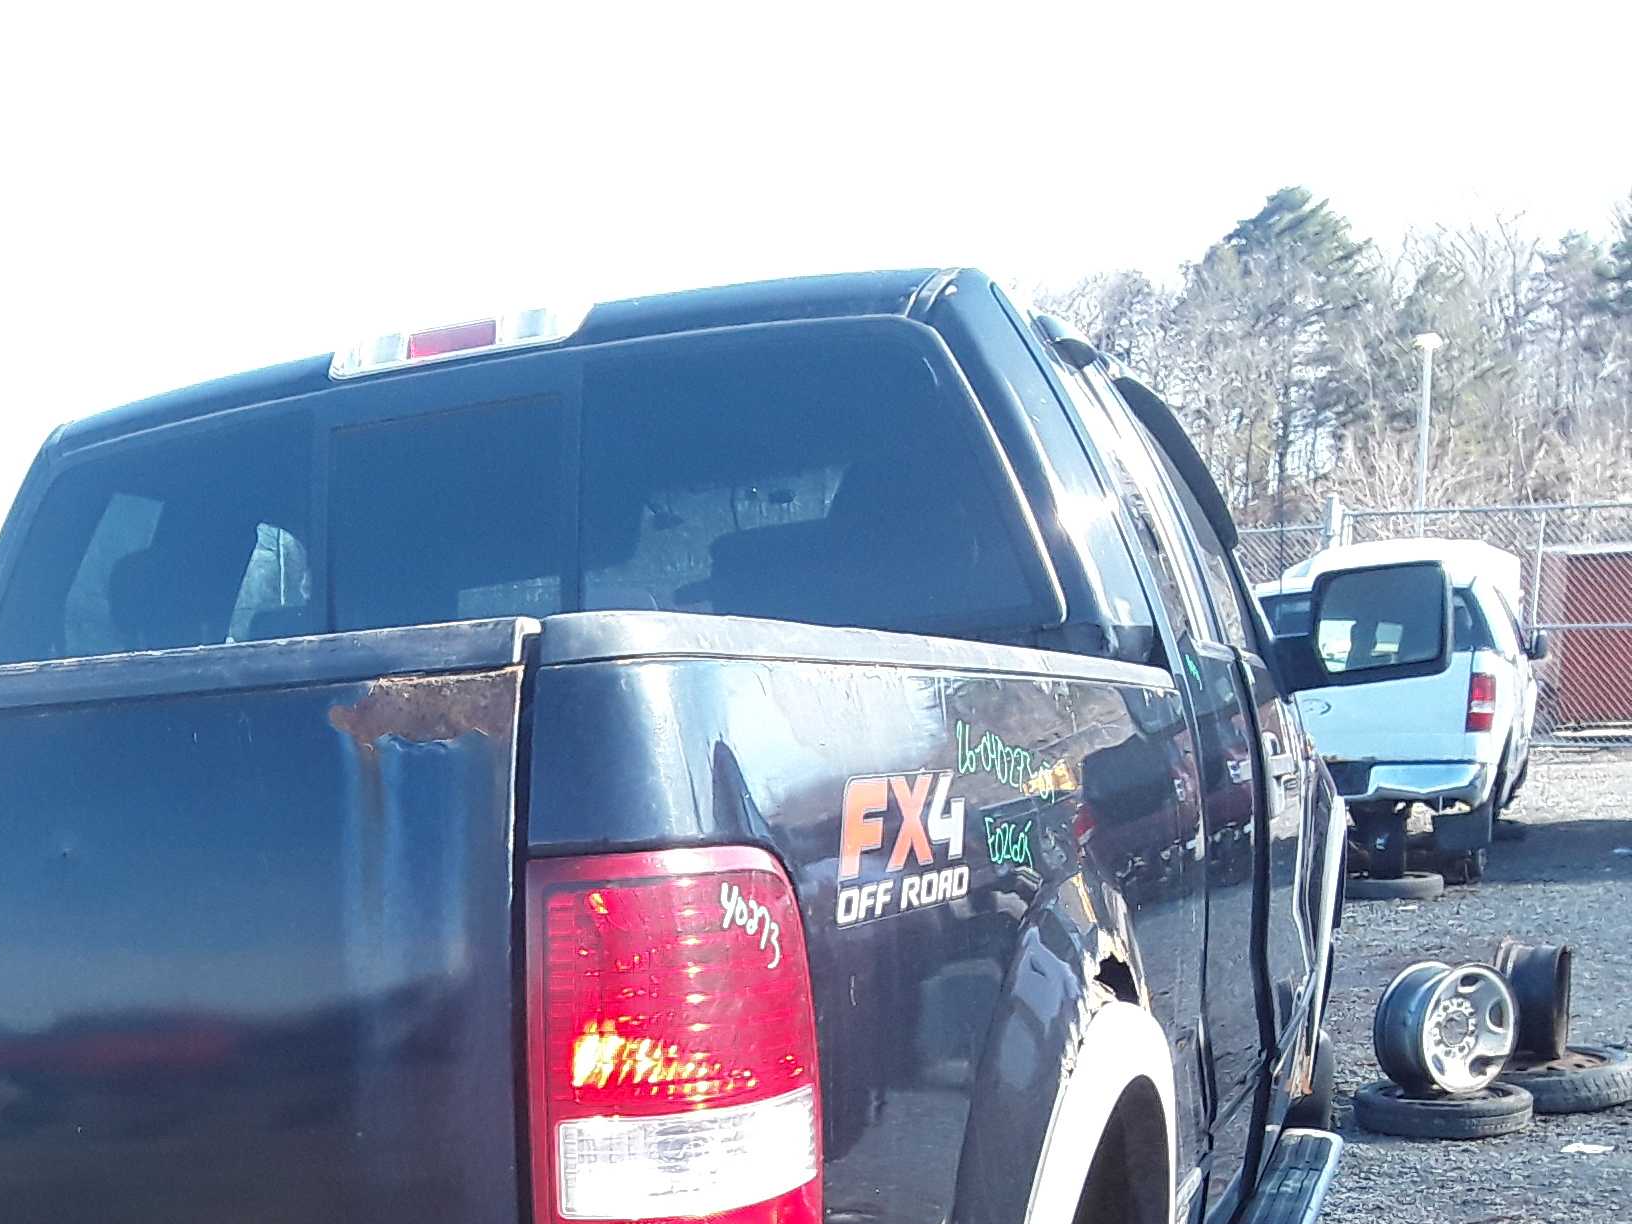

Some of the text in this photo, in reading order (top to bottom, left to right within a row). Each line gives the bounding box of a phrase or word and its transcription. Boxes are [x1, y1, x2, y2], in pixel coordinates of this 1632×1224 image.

[838, 772, 965, 882] FX4
[836, 865, 970, 926] OFF ROAD
